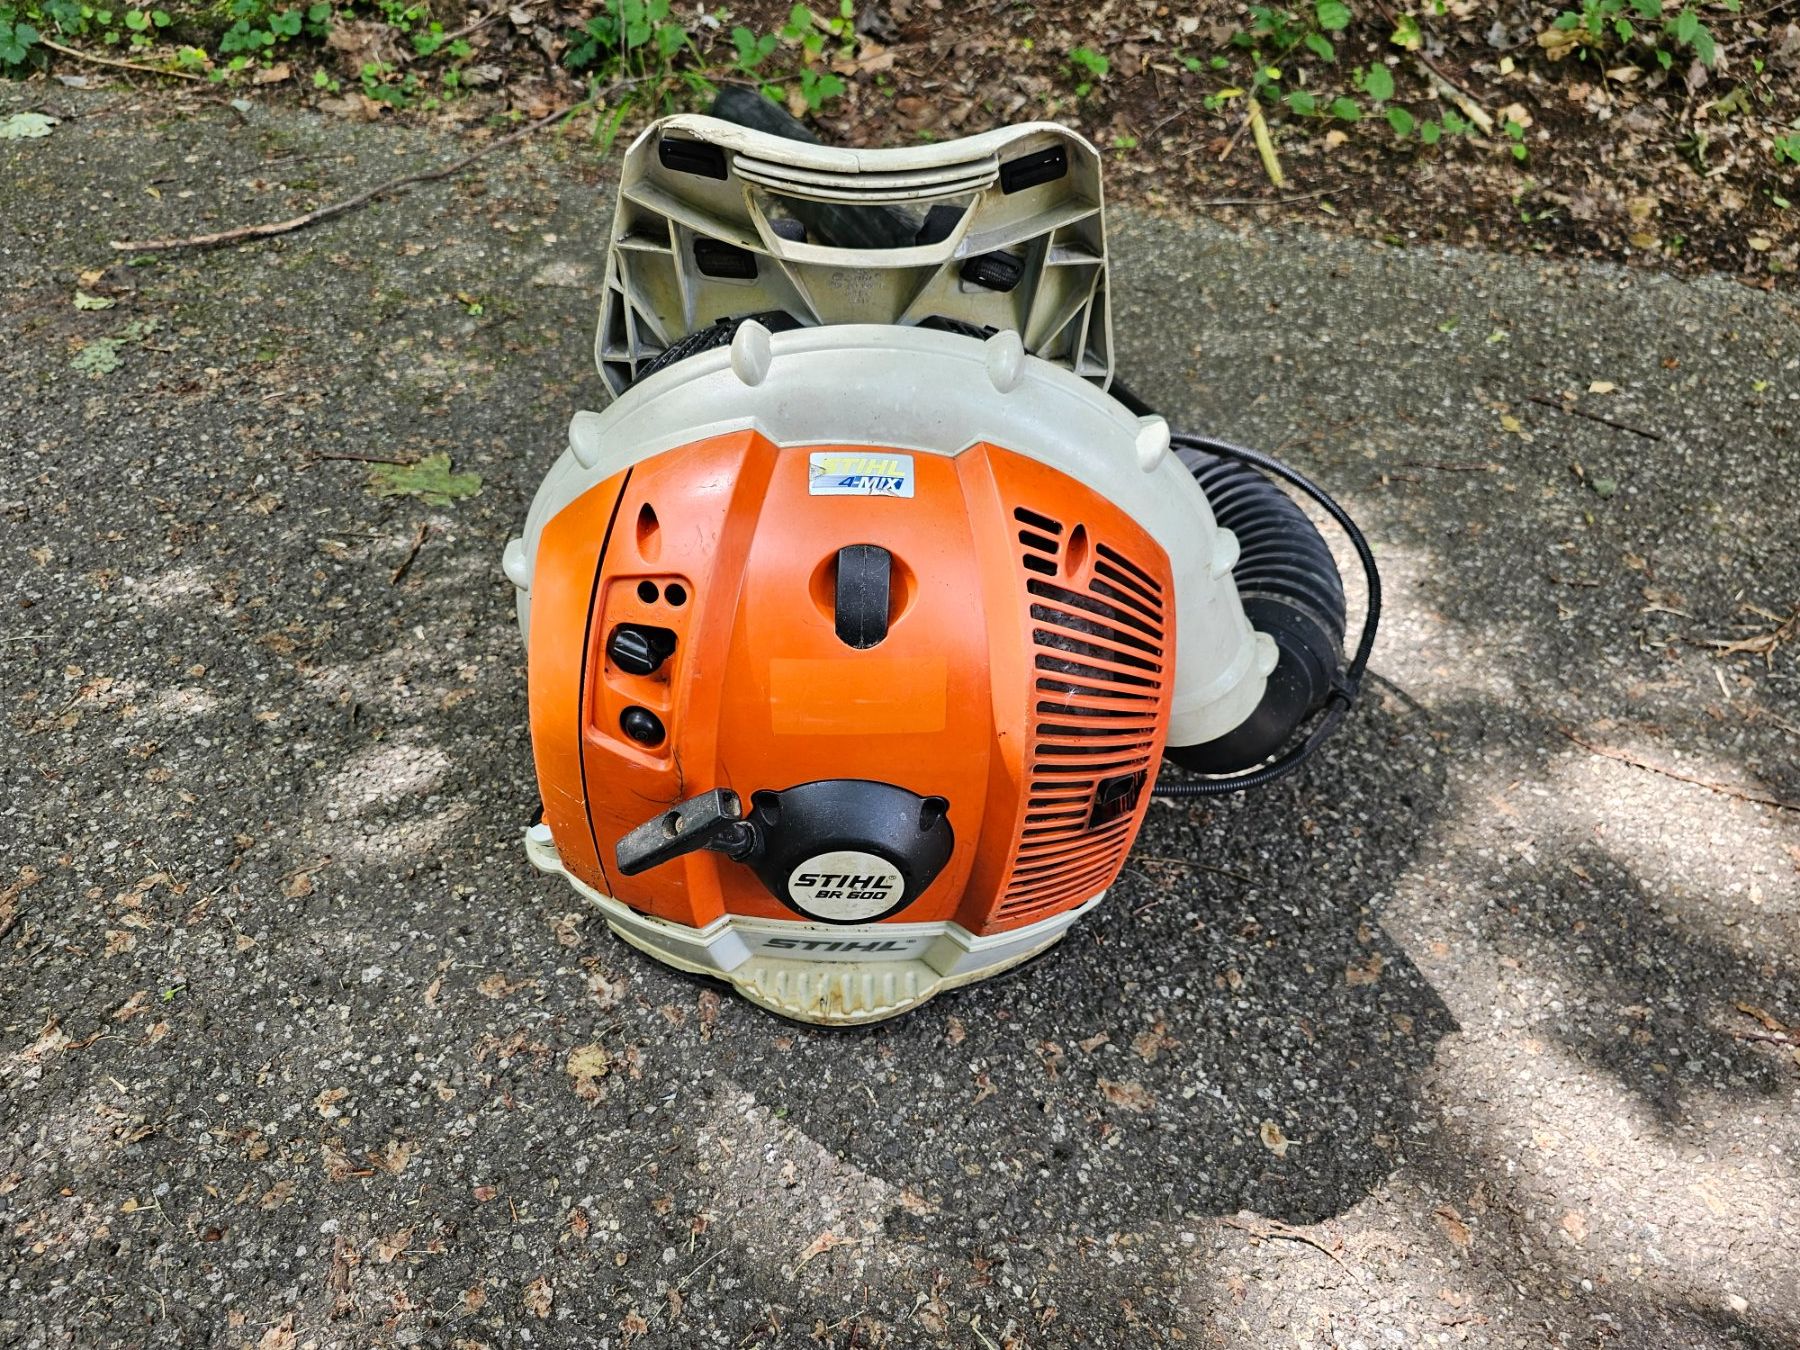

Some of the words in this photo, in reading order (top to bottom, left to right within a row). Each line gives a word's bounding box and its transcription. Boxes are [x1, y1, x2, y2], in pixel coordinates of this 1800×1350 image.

[820, 457, 905, 477] STIHL
[838, 475, 903, 491] 4-MIX
[815, 890, 843, 899] BR
[847, 891, 888, 900] 600
